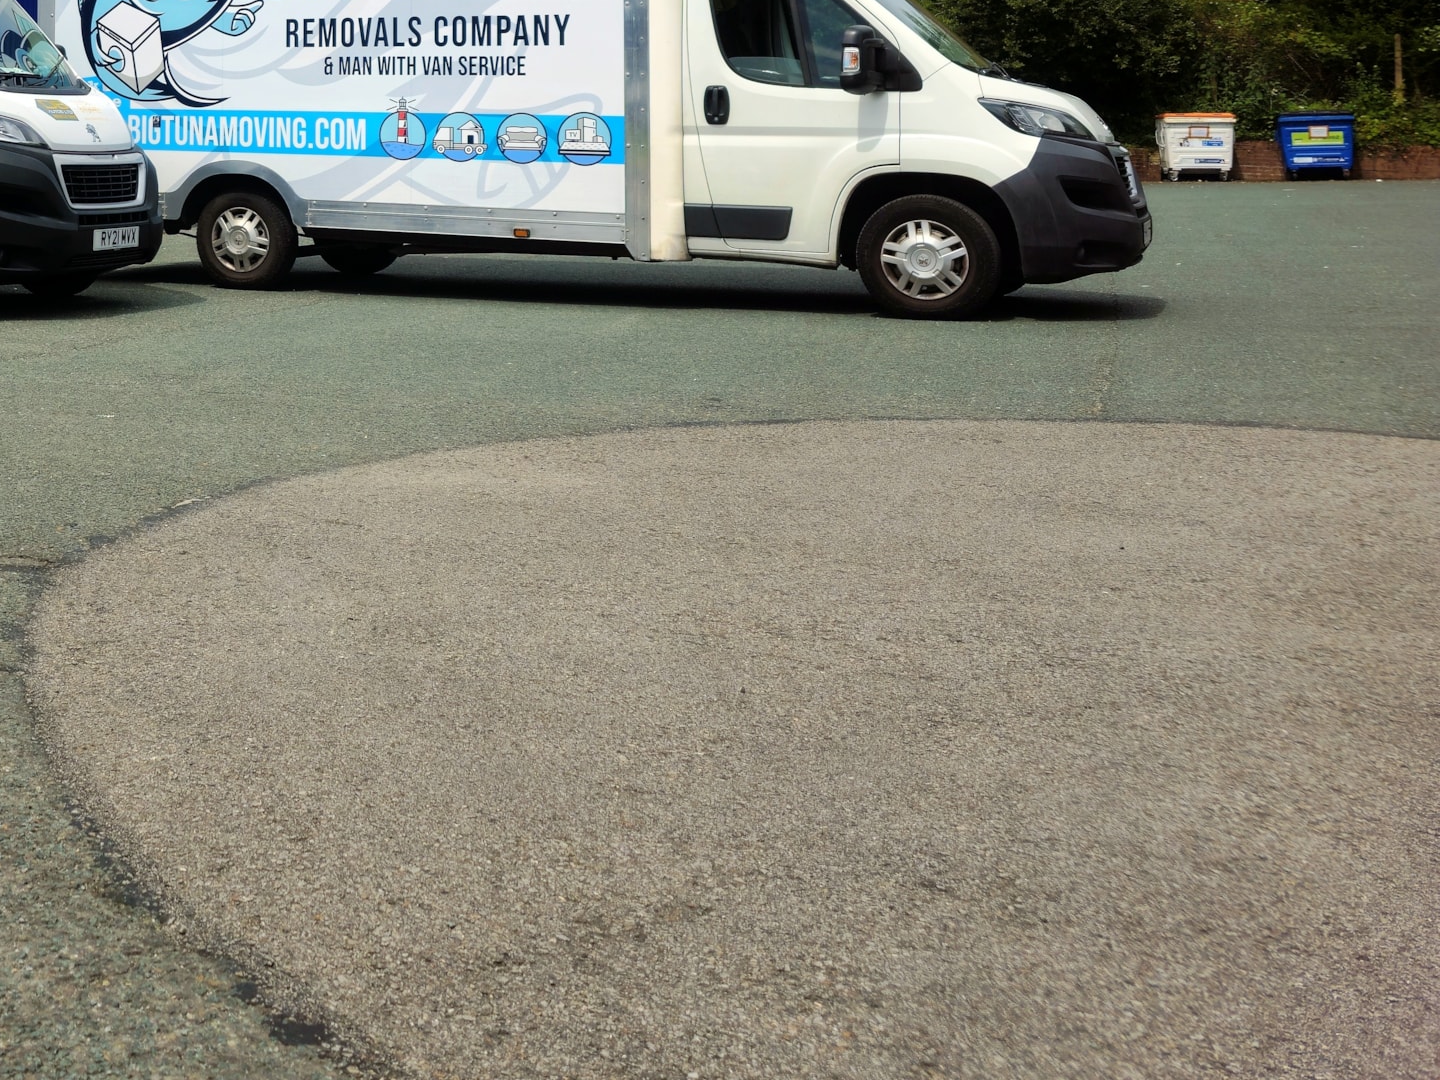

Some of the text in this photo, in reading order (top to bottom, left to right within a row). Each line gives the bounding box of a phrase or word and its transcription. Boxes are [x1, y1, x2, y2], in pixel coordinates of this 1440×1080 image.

[285, 13, 571, 48] REMOVALS COMPANY
[324, 55, 527, 76] & MAN WITH VAN SERVICE
